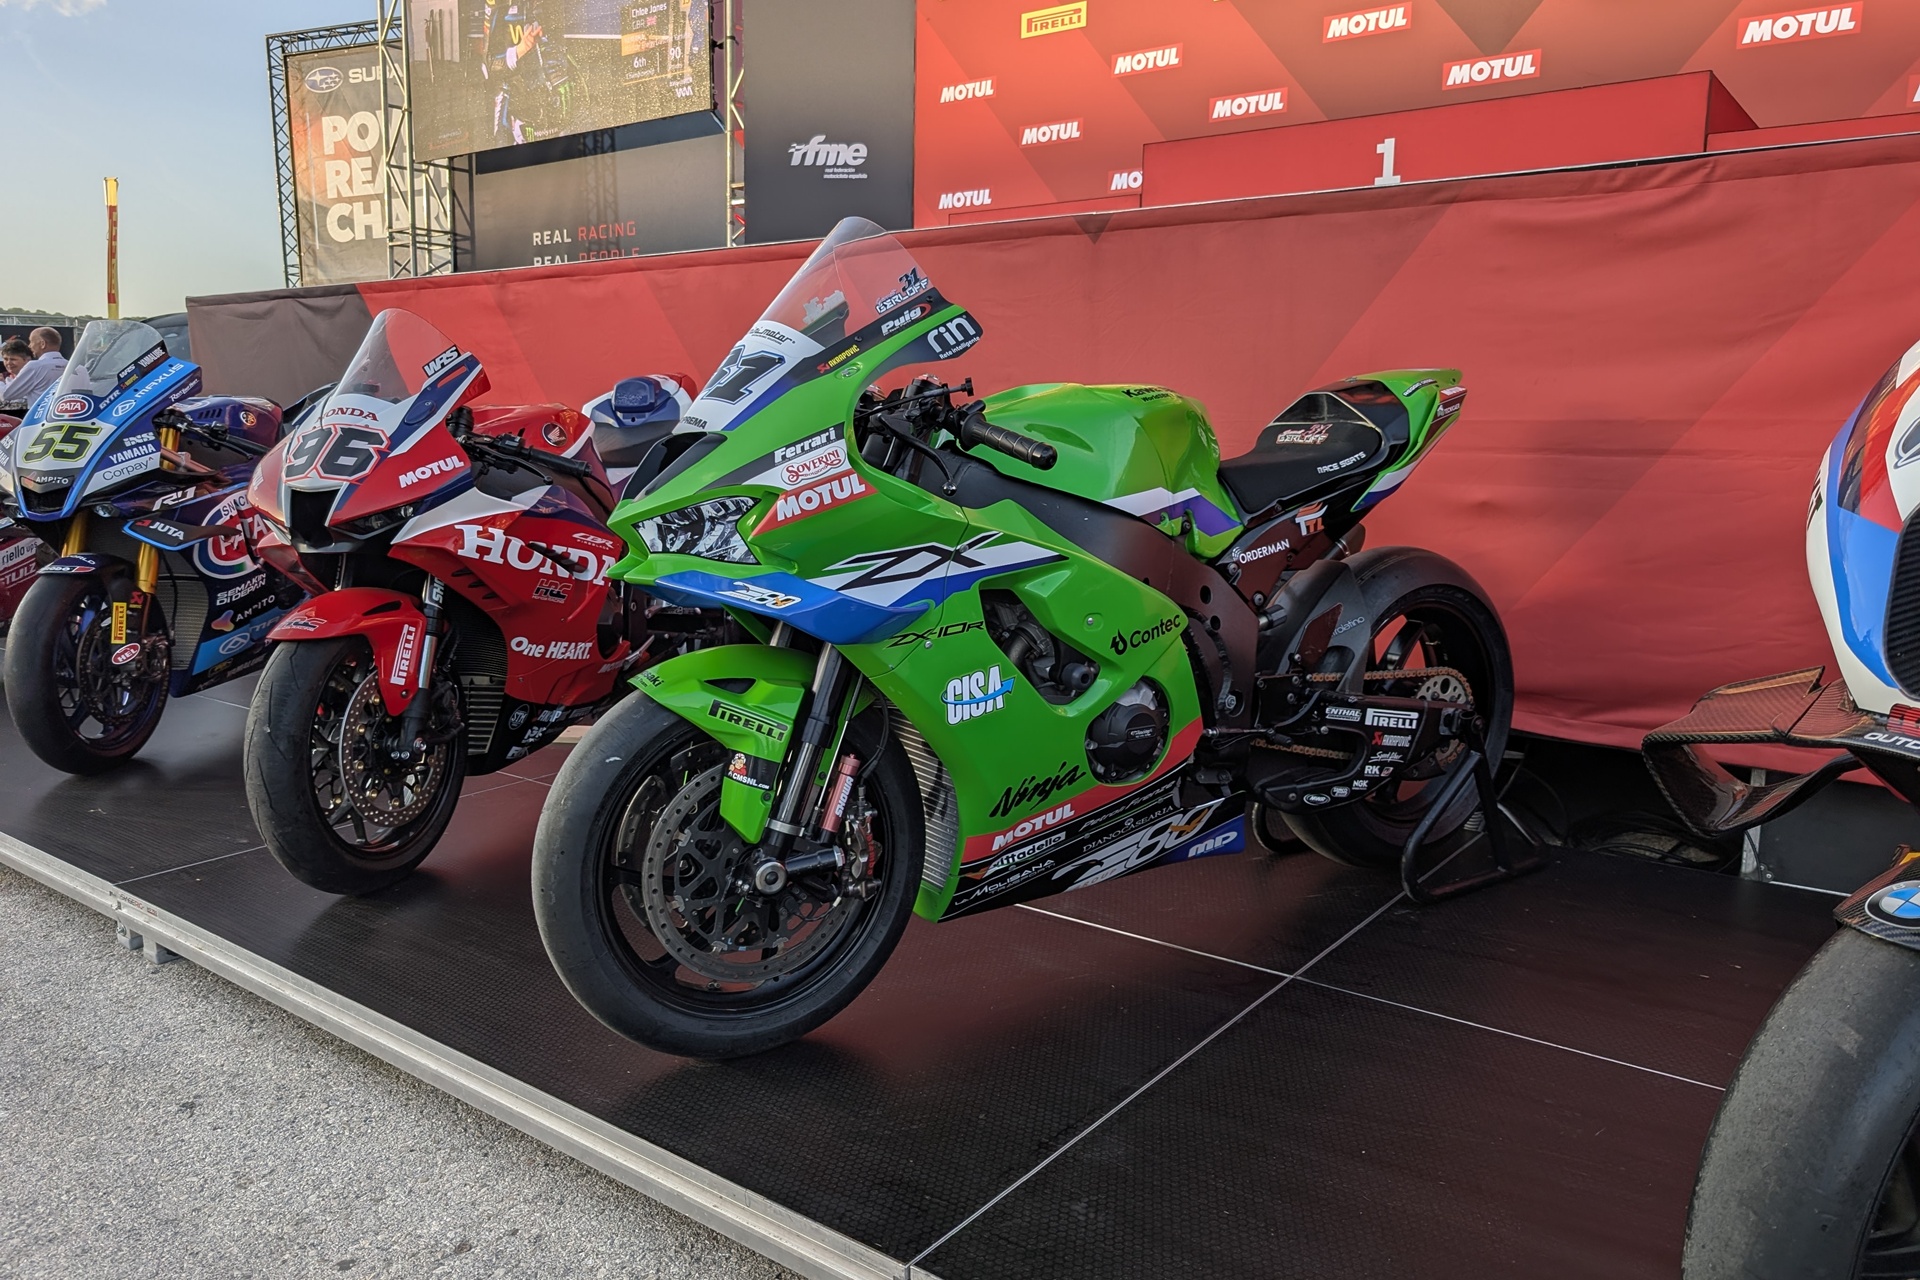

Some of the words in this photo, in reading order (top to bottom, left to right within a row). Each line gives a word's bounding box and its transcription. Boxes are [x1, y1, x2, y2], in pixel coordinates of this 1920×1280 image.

[1026, 7, 1082, 33] PIRELLI
[1325, 7, 1409, 40] MOTUL
[1741, 9, 1856, 45] MOTUL
[1114, 47, 1180, 75] MOTUL
[1446, 54, 1536, 87] MOTUL
[940, 79, 994, 103] MOTUL
[1212, 91, 1284, 119] MOTUL
[1021, 121, 1081, 146] MOTUL
[788, 134, 868, 166] rfme
[1374, 137, 1400, 186] 1
[938, 189, 992, 210] MOTUL
[533, 229, 572, 246] REAL
[578, 221, 636, 241] RACING
[899, 267, 920, 291] 31
[875, 278, 929, 314] GERLOFF
[881, 306, 922, 335] Puig
[424, 346, 460, 377] WRS
[135, 363, 184, 398] MAXUS
[58, 402, 82, 412] PATA
[99, 389, 122, 410] GYTR
[317, 407, 379, 423] HONDA
[23, 424, 102, 463] 55
[109, 444, 156, 465] YAMAHA
[282, 423, 391, 484] 96
[774, 427, 836, 463] Ferrari
[102, 458, 149, 481] Corpay
[398, 456, 464, 488] MOTUL
[776, 473, 865, 521] MOTUL
[149, 520, 184, 540] JUTA
[2, 544, 25, 565] riello
[26, 541, 38, 552] ups
[836, 532, 1003, 592] ZX
[1239, 538, 1290, 564] ORDERMAN
[217, 573, 266, 600] SEMAKIN
[217, 597, 231, 606] DI
[231, 578, 266, 602] DEPAN
[114, 605, 125, 641] PIRELLI
[883, 620, 985, 649] ZX-10R
[1129, 613, 1181, 649] Contec
[118, 648, 138, 662] HEL
[390, 624, 416, 686] PIRELLI
[510, 636, 543, 656] One
[946, 665, 1005, 725] CISA
[708, 699, 789, 742] PIRELLI
[1364, 708, 1419, 729] PIRELLI
[1364, 765, 1380, 774] RK
[835, 777, 853, 817] SHOWA
[989, 761, 1086, 818] Ninja
[991, 803, 1075, 851] MOTUL
[865, 833, 876, 875] brembo
[970, 859, 1055, 900] MOLISANA
